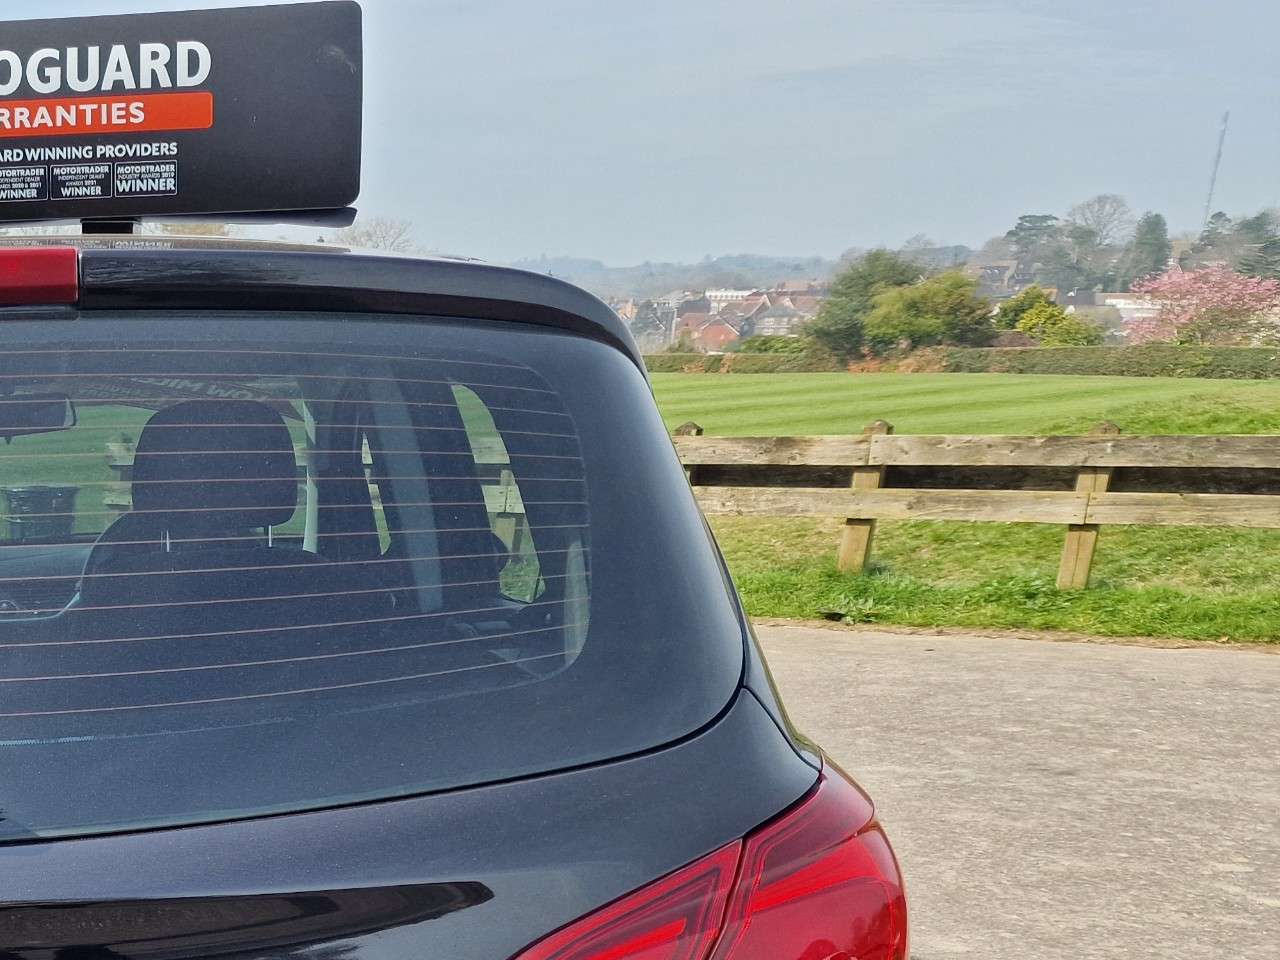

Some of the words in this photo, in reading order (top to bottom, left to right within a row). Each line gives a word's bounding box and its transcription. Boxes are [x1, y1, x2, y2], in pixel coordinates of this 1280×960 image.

[25, 146, 93, 161] WINNING
[96, 142, 178, 159] PROVIDERS
[53, 166, 110, 175] MOTORTRADER
[117, 164, 176, 174] MOTORTRADER
[116, 178, 176, 192] WINNER
[61, 186, 102, 197] WINNER
